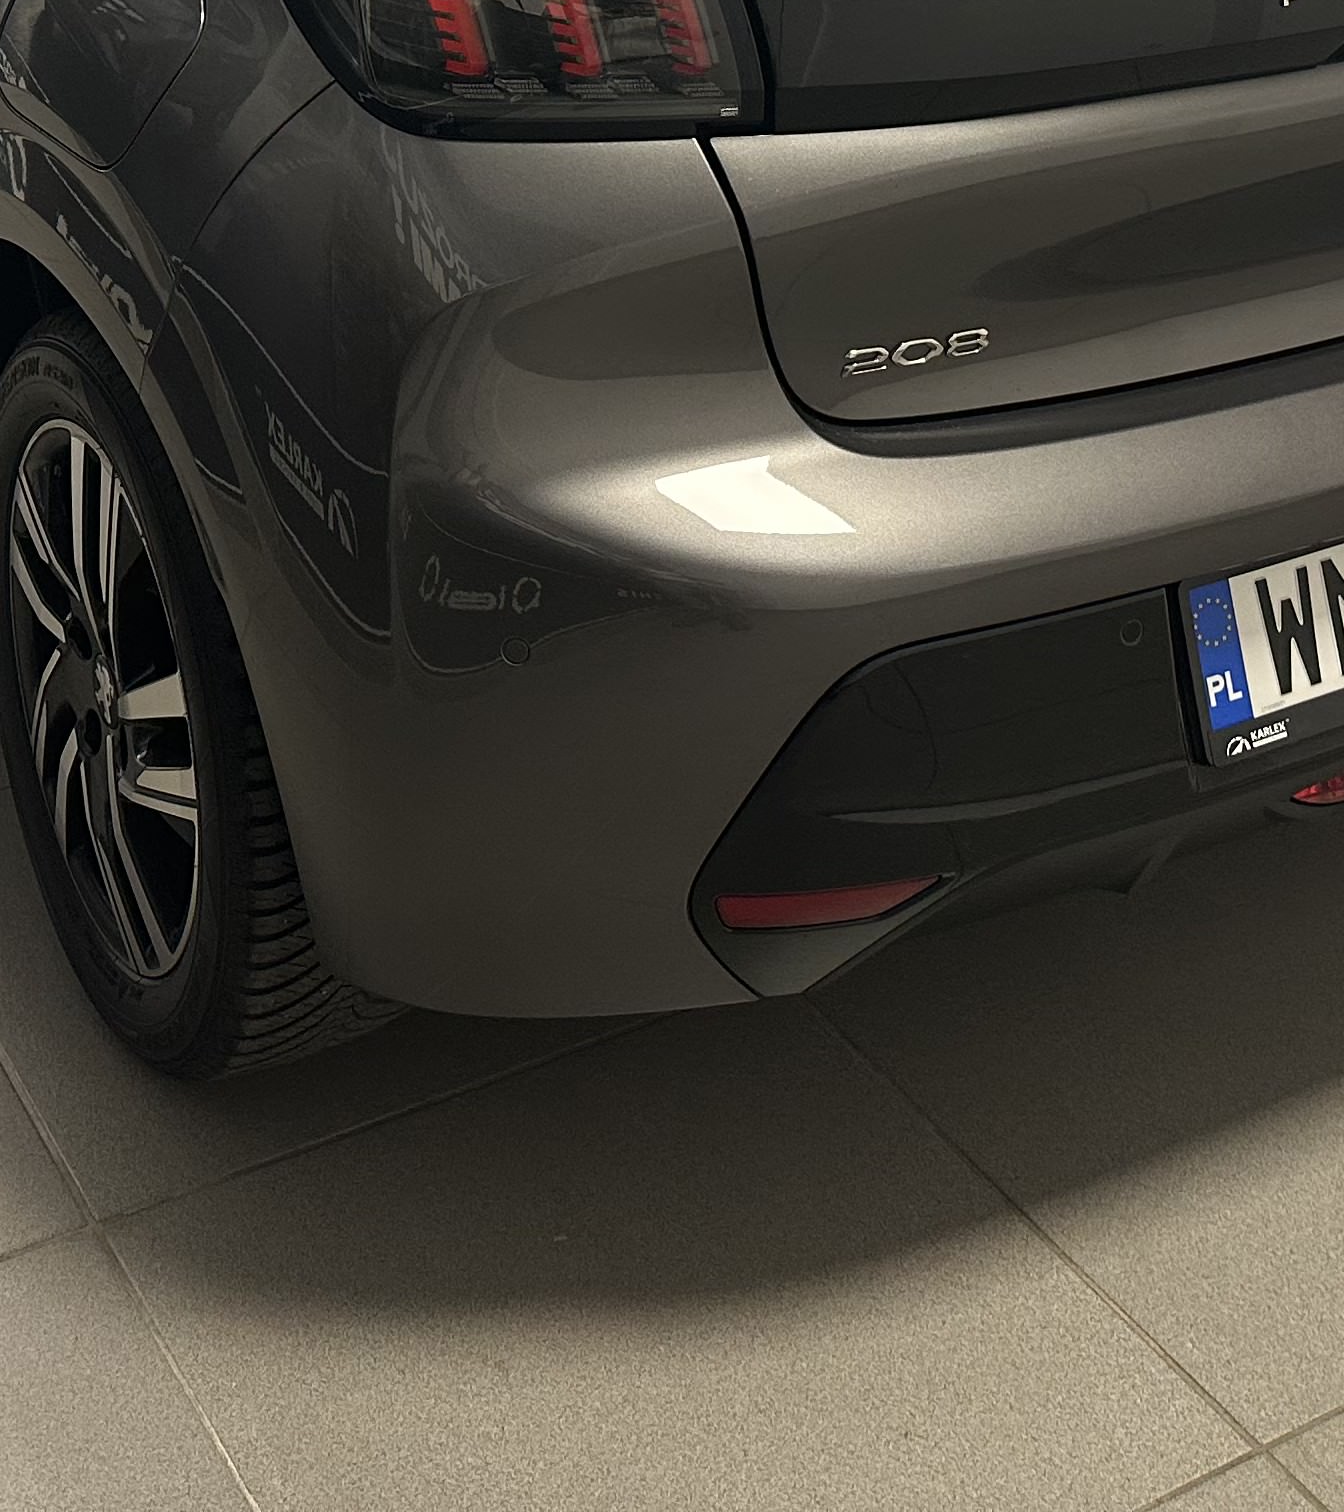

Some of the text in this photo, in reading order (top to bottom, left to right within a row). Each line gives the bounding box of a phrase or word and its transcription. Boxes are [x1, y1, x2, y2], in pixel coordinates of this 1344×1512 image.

[840, 328, 991, 379] 208
[1205, 670, 1243, 707] PL
[1250, 720, 1286, 742] KARLEX
